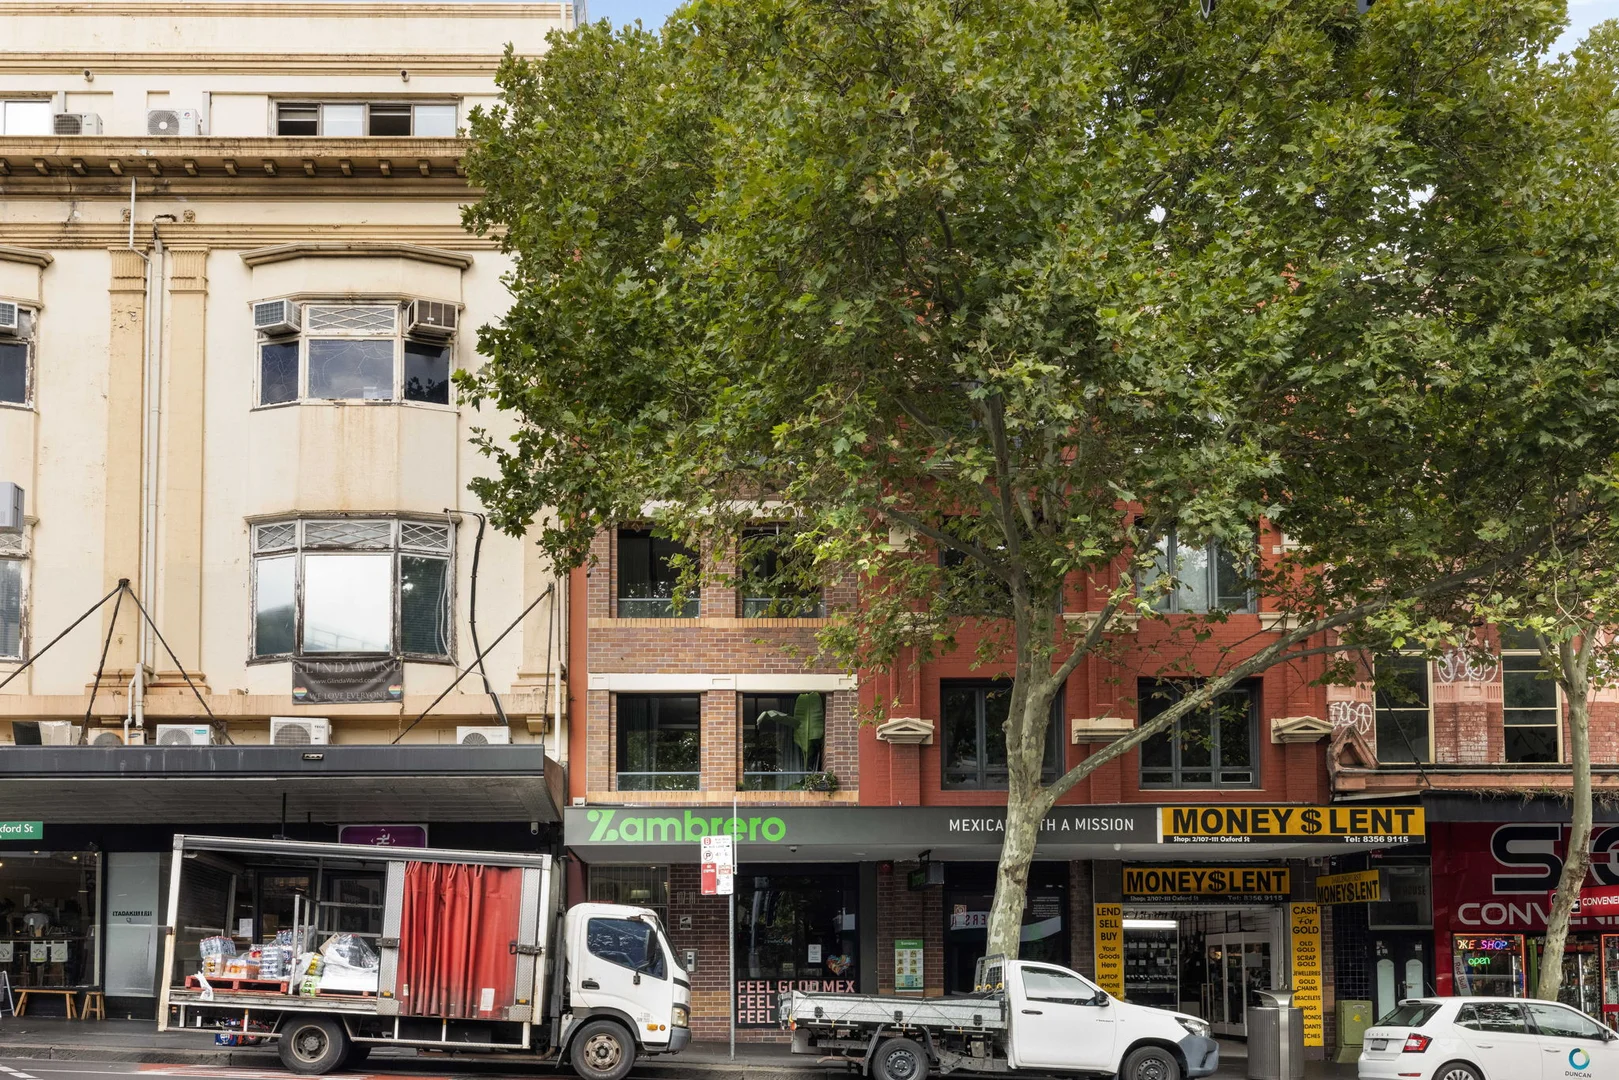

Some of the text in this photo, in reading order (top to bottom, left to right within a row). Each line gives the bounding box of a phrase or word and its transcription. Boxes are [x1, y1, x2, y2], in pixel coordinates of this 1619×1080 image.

[293, 661, 402, 673] GLINDAWAND
[346, 691, 387, 699] EVERYONE
[24, 823, 34, 833] St
[587, 809, 787, 842] Zambrero
[950, 818, 1134, 832] MEXICA TH A MISSION
[1097, 908, 1121, 916] LEND
[1292, 906, 1318, 915] CASH
[1099, 919, 1119, 928] SELL
[1292, 926, 1319, 934] GOLD
[1100, 932, 1117, 941] BUY
[1481, 940, 1508, 950] SHOP
[1467, 957, 1491, 967] open
[737, 980, 776, 993] FEEL
[822, 980, 855, 993] MEX
[737, 995, 776, 1009] FEEL
[737, 1010, 776, 1023] FEEL
